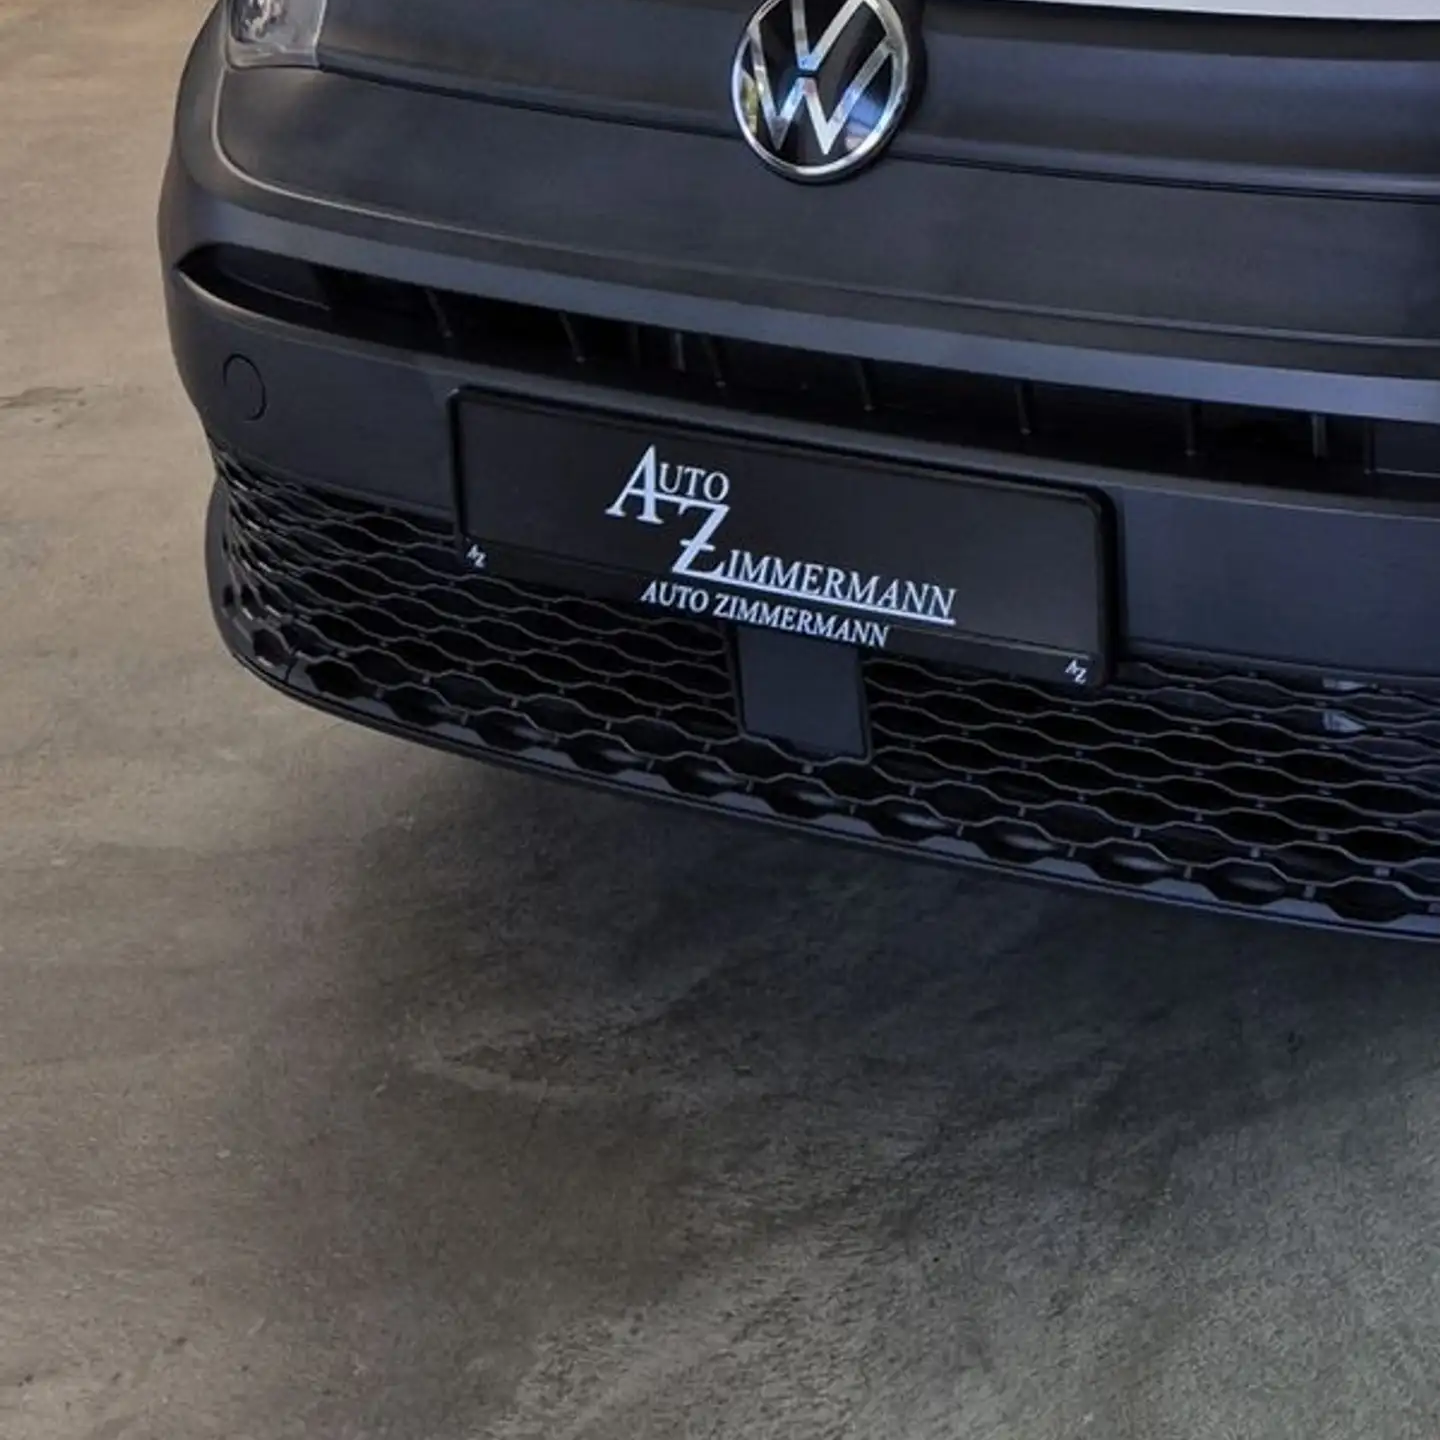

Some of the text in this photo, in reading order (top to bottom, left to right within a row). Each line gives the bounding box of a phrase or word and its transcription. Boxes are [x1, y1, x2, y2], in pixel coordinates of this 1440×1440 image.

[606, 444, 730, 525] AUTO
[671, 498, 958, 627] ZIMMERMANN
[641, 579, 890, 648] AUTO ZIMMERMANN
